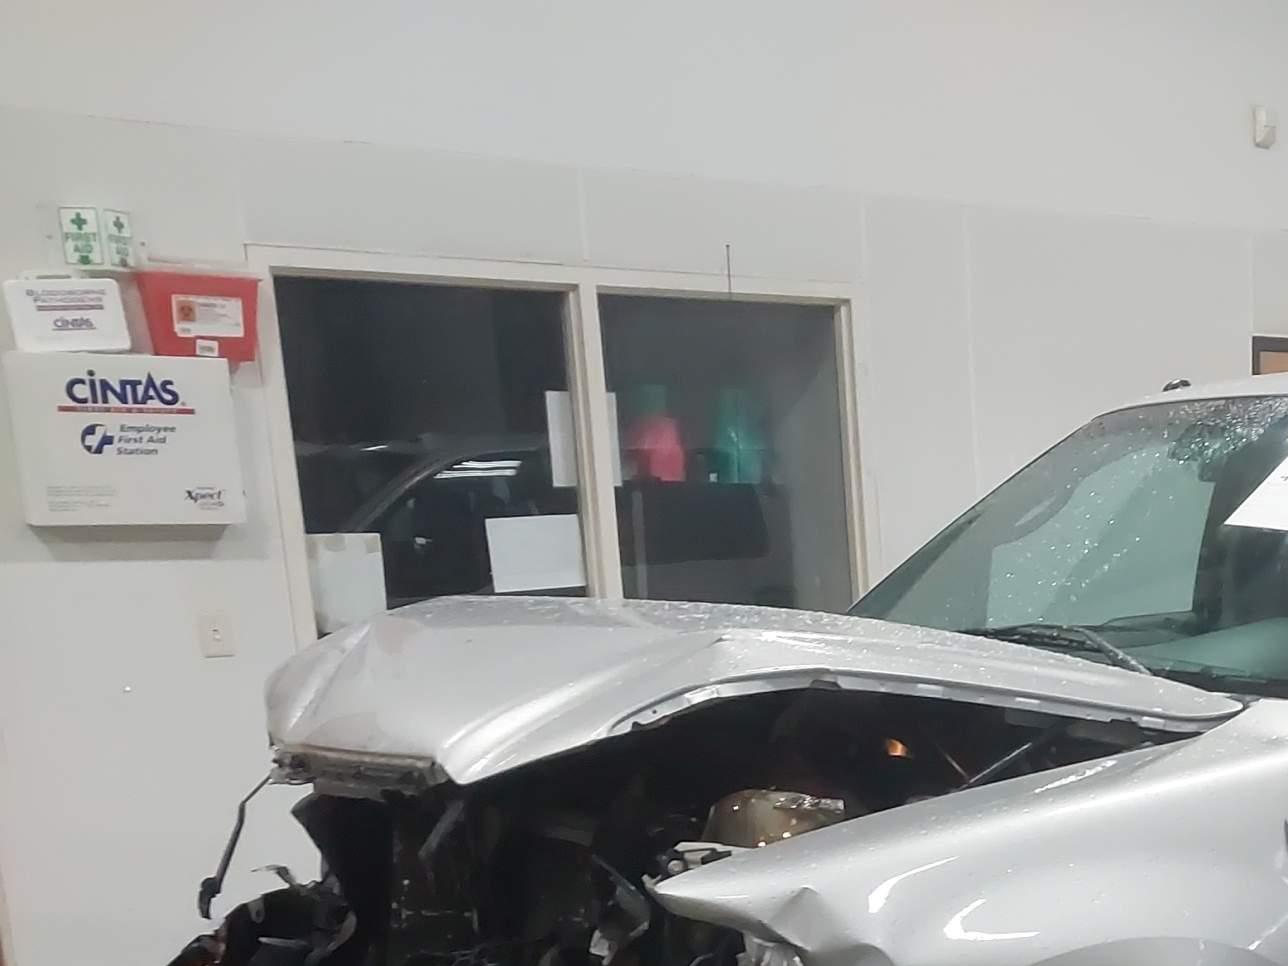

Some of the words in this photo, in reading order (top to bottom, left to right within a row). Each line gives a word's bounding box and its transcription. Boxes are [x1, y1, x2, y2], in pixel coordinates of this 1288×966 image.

[65, 369, 180, 406] CINTAS
[119, 424, 177, 434] Employee
[117, 435, 143, 444] First
[146, 435, 167, 444] Aid
[116, 446, 159, 455] Station
